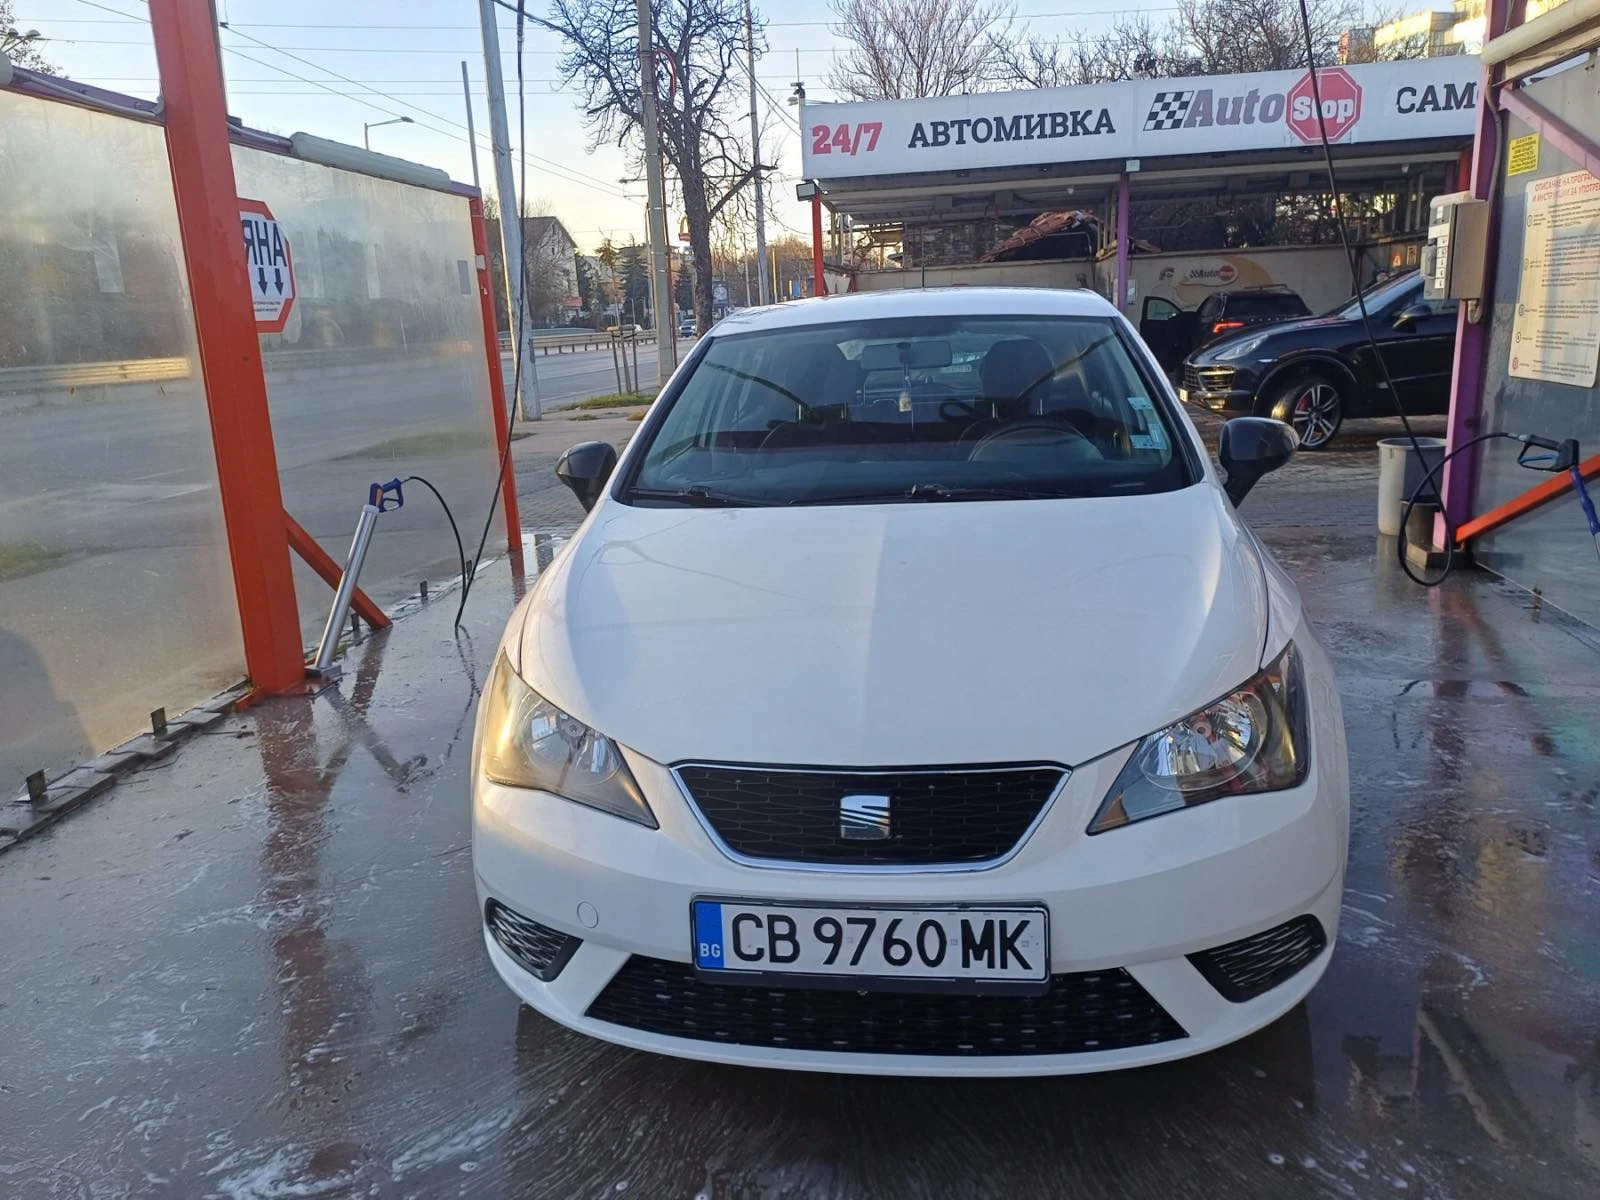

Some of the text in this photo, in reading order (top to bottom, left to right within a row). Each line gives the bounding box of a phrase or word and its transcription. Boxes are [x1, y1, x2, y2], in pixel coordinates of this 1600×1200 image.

[1183, 87, 1286, 129] Auto
[1396, 82, 1478, 115] САМ
[812, 108, 1116, 156] 24/7 АВТОМИВКА
[241, 219, 288, 267] ЯНА
[699, 942, 721, 958] BG
[731, 912, 1033, 970] CB 9760 MK
